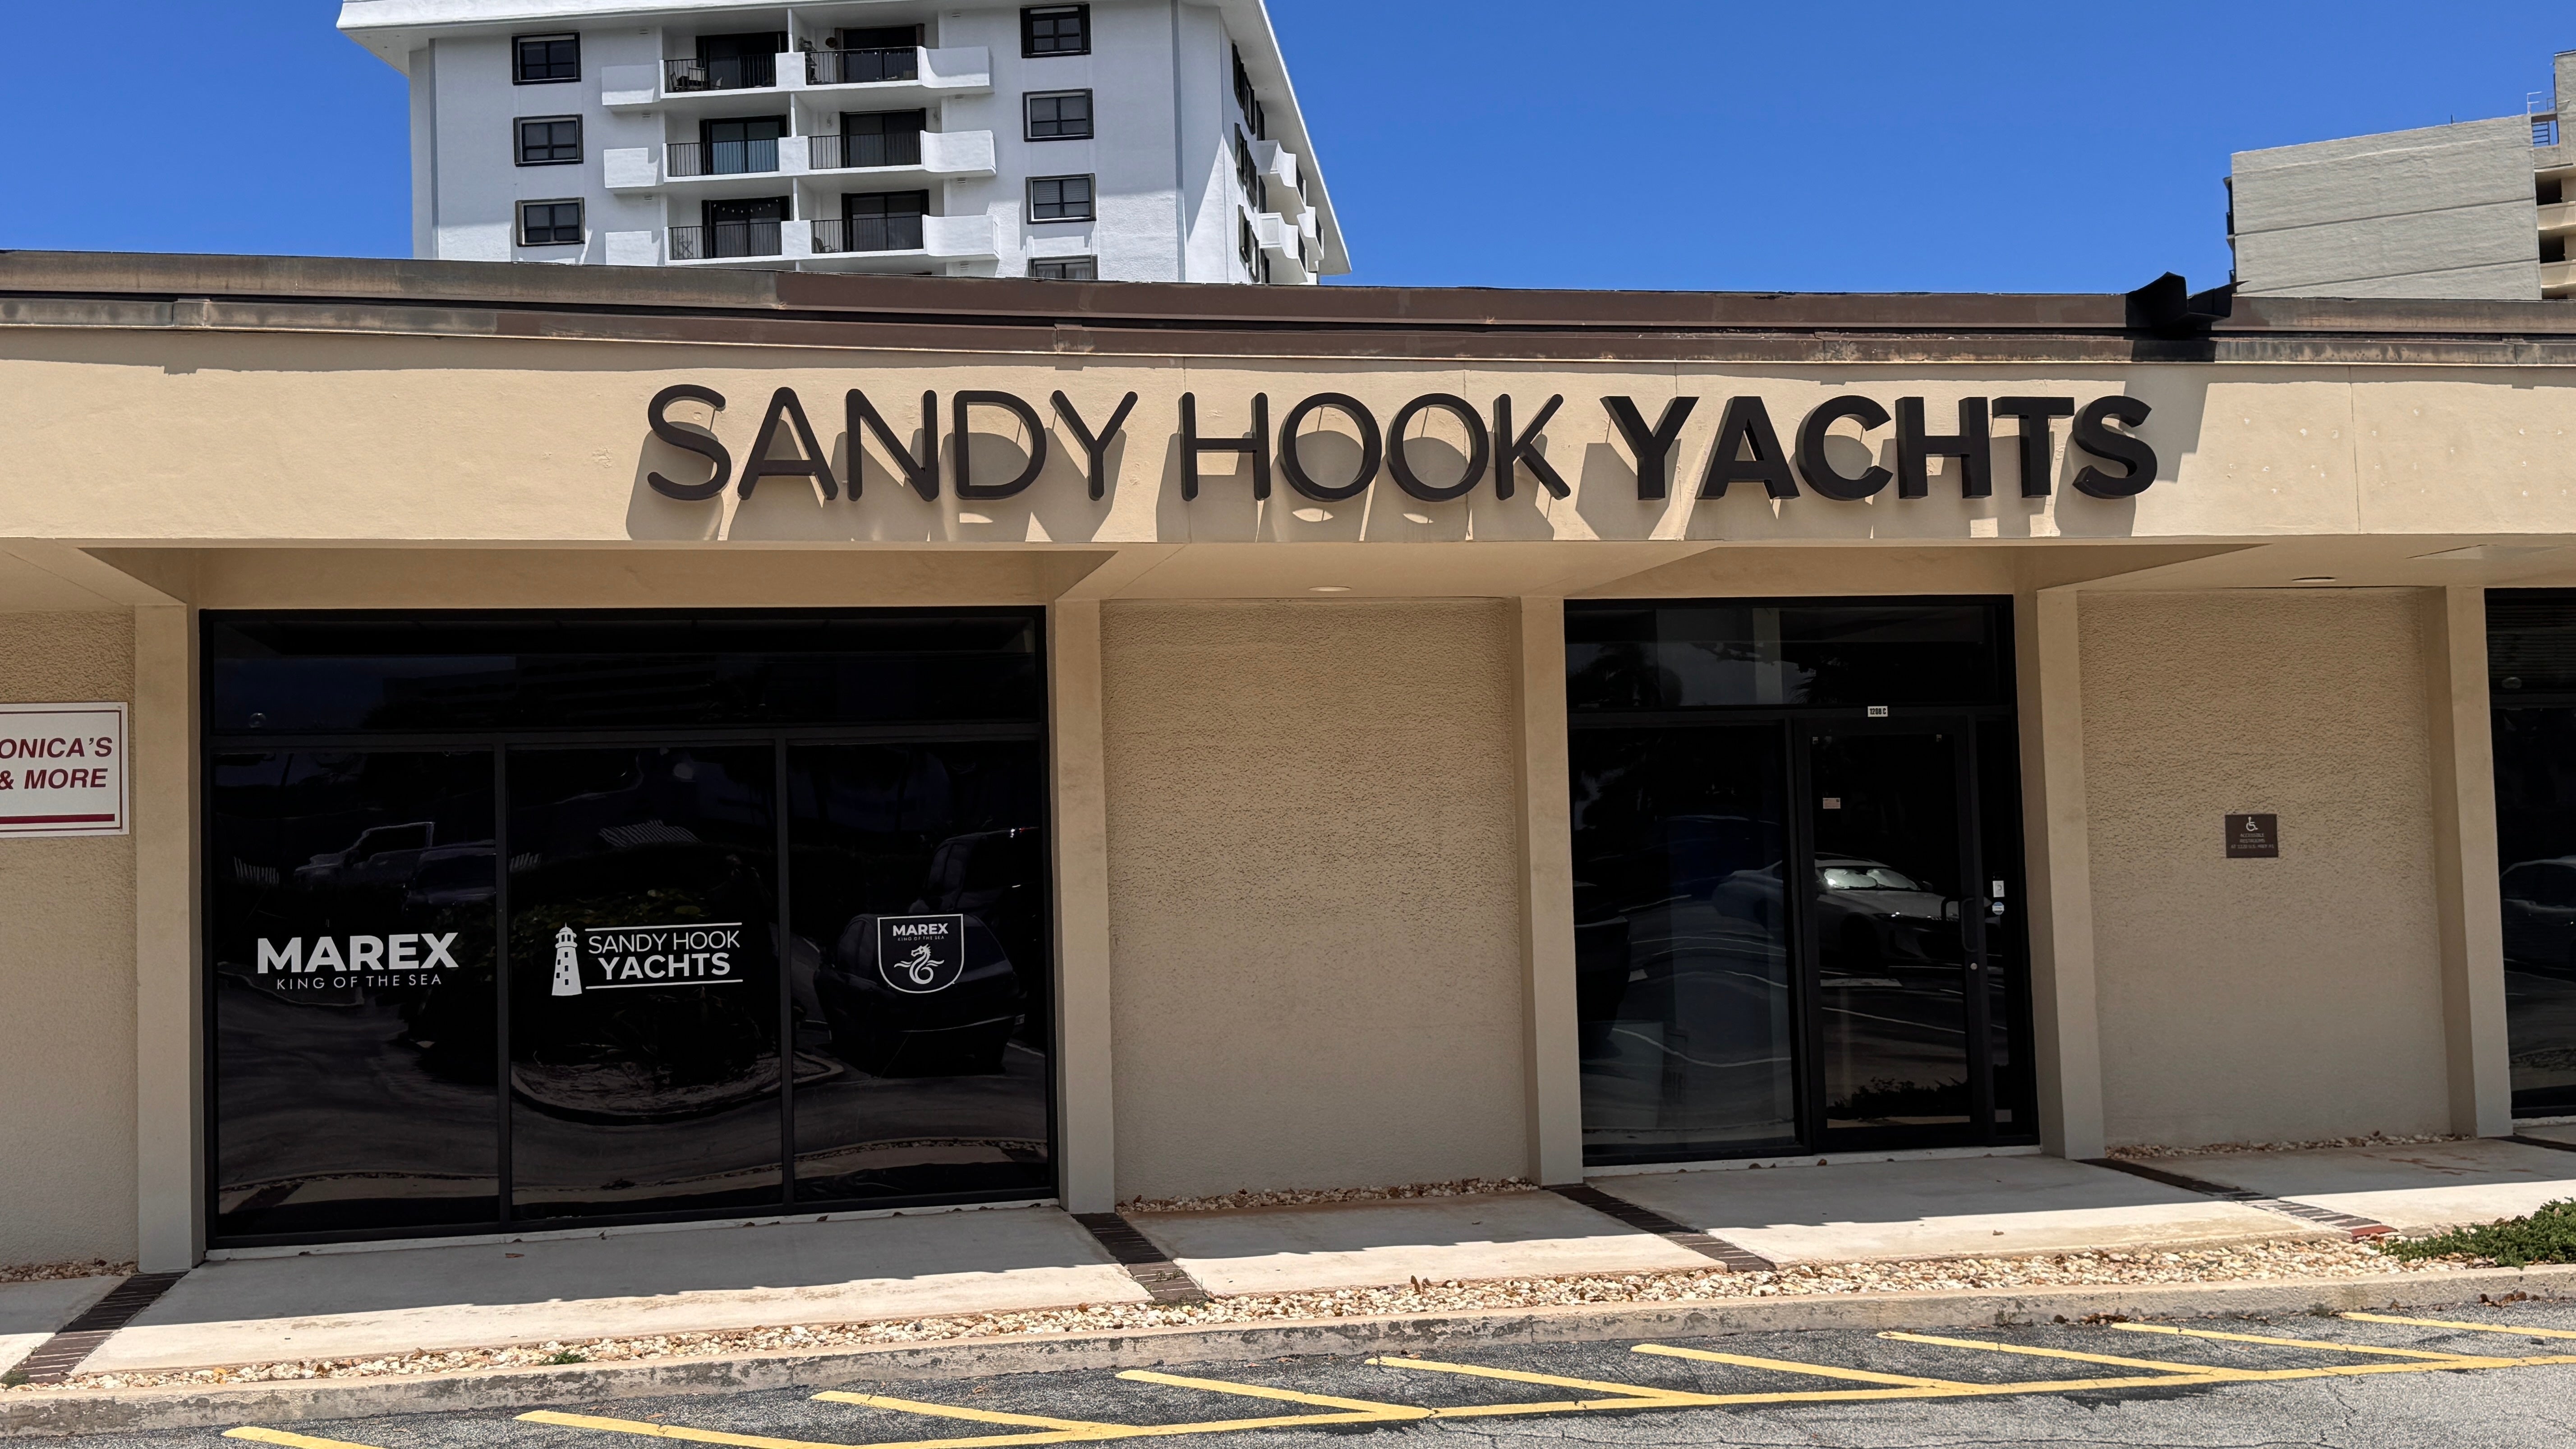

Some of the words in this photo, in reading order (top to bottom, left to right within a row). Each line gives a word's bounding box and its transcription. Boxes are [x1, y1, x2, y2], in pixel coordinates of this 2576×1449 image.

[647, 384, 1138, 501] SANDY
[1178, 392, 1571, 502] HOOK
[1600, 395, 2158, 501] YACHTS
[0, 737, 113, 759] ONICA'S
[0, 770, 14, 790] &
[24, 768, 108, 789] MORE
[893, 923, 948, 936] MAREX
[258, 932, 459, 974] MAREX
[589, 933, 667, 954] SANDY
[673, 930, 740, 950] HOOK
[598, 952, 731, 980] YACHTS
[277, 978, 325, 989] KING
[334, 976, 357, 988] OF
[366, 975, 400, 987] THE
[409, 974, 442, 986] SEA
